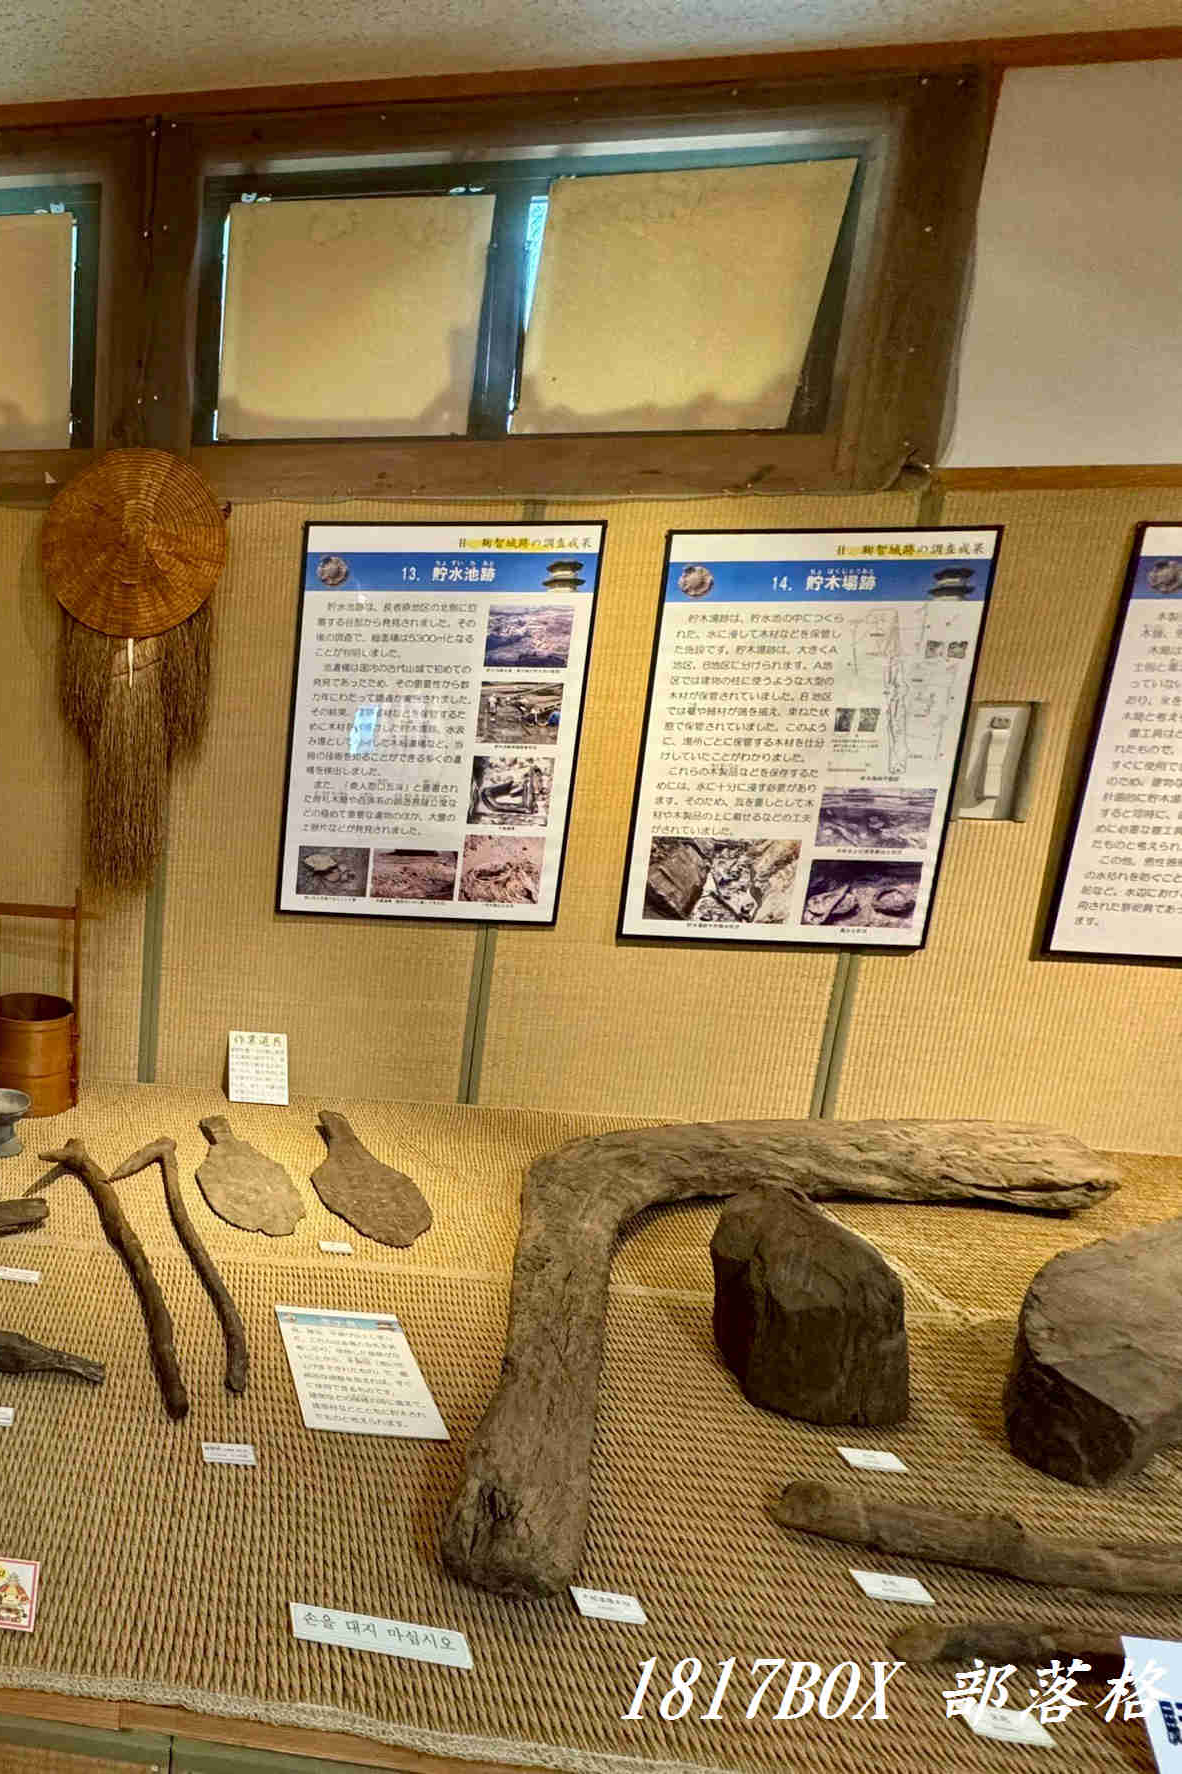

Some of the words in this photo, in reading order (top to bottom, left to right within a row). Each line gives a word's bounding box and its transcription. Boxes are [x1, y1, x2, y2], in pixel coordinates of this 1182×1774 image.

[401, 567, 421, 581] 13.
[432, 567, 497, 582] 貯水池跡
[772, 576, 794, 591] 14.
[805, 575, 878, 591] 貯木場跡
[303, 1611, 335, 1631] 손을
[345, 1619, 378, 1639] 대지
[386, 1626, 458, 1651] 마십시오
